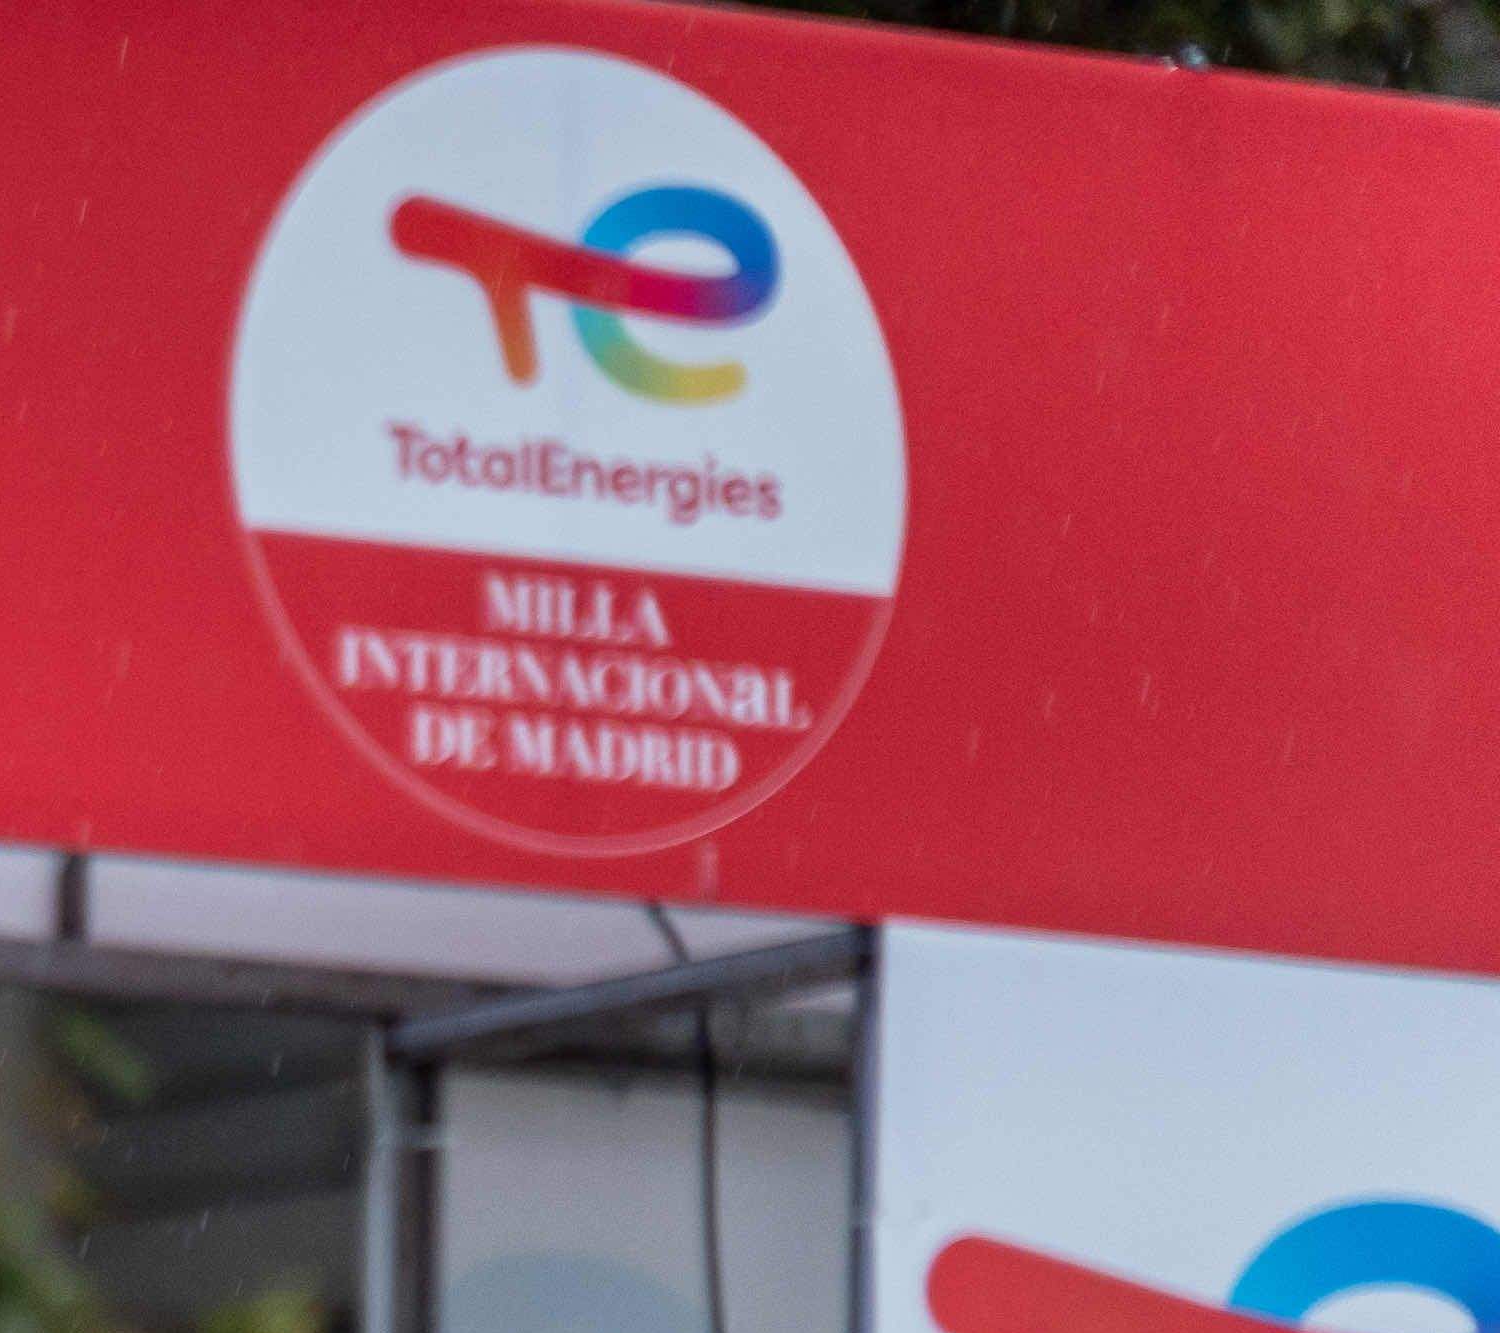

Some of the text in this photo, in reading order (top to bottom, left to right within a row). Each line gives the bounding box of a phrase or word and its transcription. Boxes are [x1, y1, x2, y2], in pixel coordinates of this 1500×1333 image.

[388, 420, 783, 524] TotalEnergies
[486, 577, 672, 648] MILLA
[410, 705, 739, 793] DE MADRID
